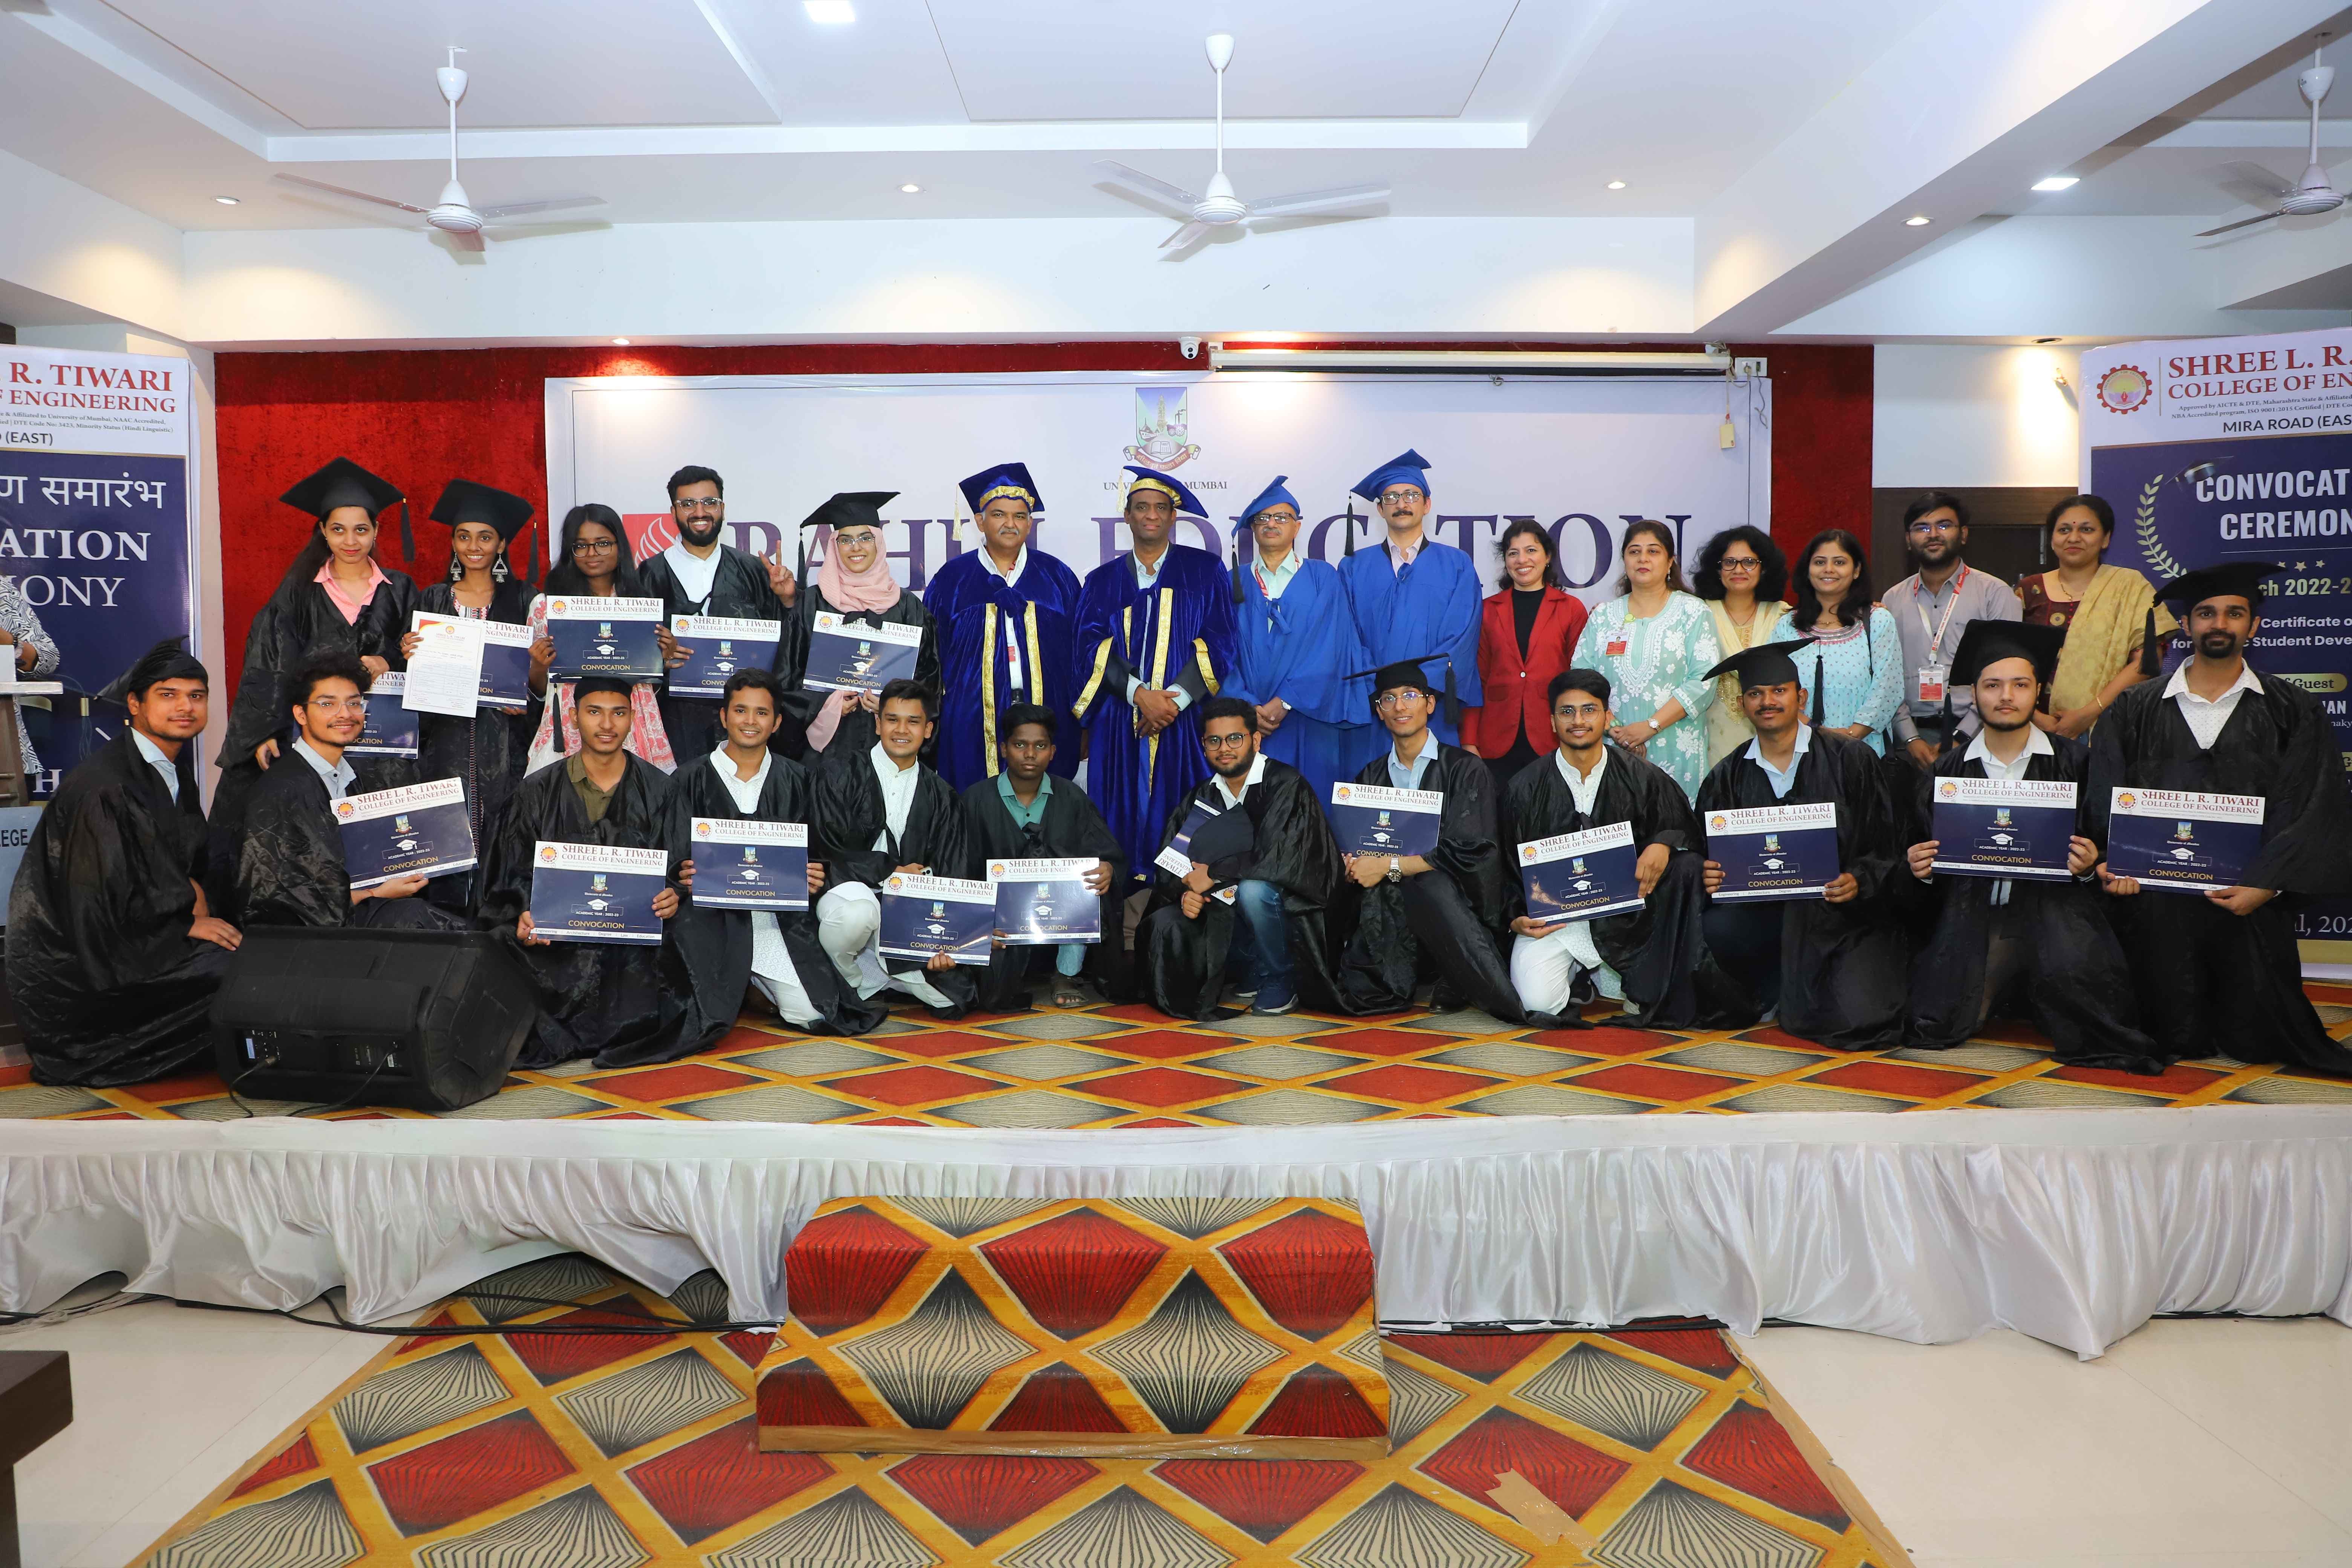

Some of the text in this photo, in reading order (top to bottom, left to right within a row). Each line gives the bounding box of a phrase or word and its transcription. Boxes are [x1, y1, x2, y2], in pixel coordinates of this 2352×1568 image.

[2168, 351, 2278, 378] SHREE
[2285, 349, 2313, 369] L.
[9, 362, 173, 391] R. TIWARI
[2168, 378, 2277, 399] COLLEGE
[2283, 375, 2316, 391] OF
[9, 389, 176, 412] ENGINEERING
[2223, 420, 2264, 433] MIRA
[2268, 417, 2314, 430] ROAD
[6, 431, 53, 446] (EAST)
[39, 472, 167, 509] समारंभ
[1184, 481, 1227, 490] MUMBAI
[6, 575, 126, 606] ONY
[2261, 616, 2341, 628] Certificate
[2252, 636, 2312, 647] Student
[1962, 779, 2000, 789] SHREE
[2003, 781, 2012, 789] L.
[2029, 782, 2072, 791] TIWARI
[357, 791, 393, 804] SHREE
[395, 789, 404, 797] L.
[406, 787, 416, 795] R.
[359, 799, 394, 811] COLLEGE
[407, 788, 459, 802] ENGINEERING
[2014, 791, 2072, 799] ENGINEERING
[2142, 790, 2259, 807] SHREE L. R. TIWARI
[1731, 808, 1765, 819] SHREE
[1792, 804, 1831, 814] TIWARI
[2141, 800, 2181, 809] COLLEGE
[2197, 804, 2259, 814] ENGINEERING
[1779, 813, 1831, 822] ENGINEERING
[0, 829, 28, 847] EGE
[1540, 835, 1570, 848] SHREE
[1582, 831, 1591, 839] R.
[1592, 823, 1627, 837] TIWARI
[1541, 844, 1571, 854] COLLEGE
[1583, 831, 1629, 845] ENGINEERING
[562, 844, 597, 854] SHREE
[600, 847, 609, 856] L.
[625, 849, 663, 859] TIWARI
[1971, 854, 2031, 864] CONVOCATION
[383, 856, 438, 873] CONVOCATION
[611, 857, 663, 867] ENGINEERING
[2149, 869, 2213, 880] CONVOCATION
[906, 883, 936, 892] COLLEGE
[948, 888, 993, 896] ENGINEERING
[907, 875, 938, 886] SHREE
[960, 881, 993, 890] TIWARI
[1748, 879, 1803, 887] CONVOCATION
[1561, 896, 1610, 911] CONVOCATION
[568, 920, 625, 929] CONVOCATION
